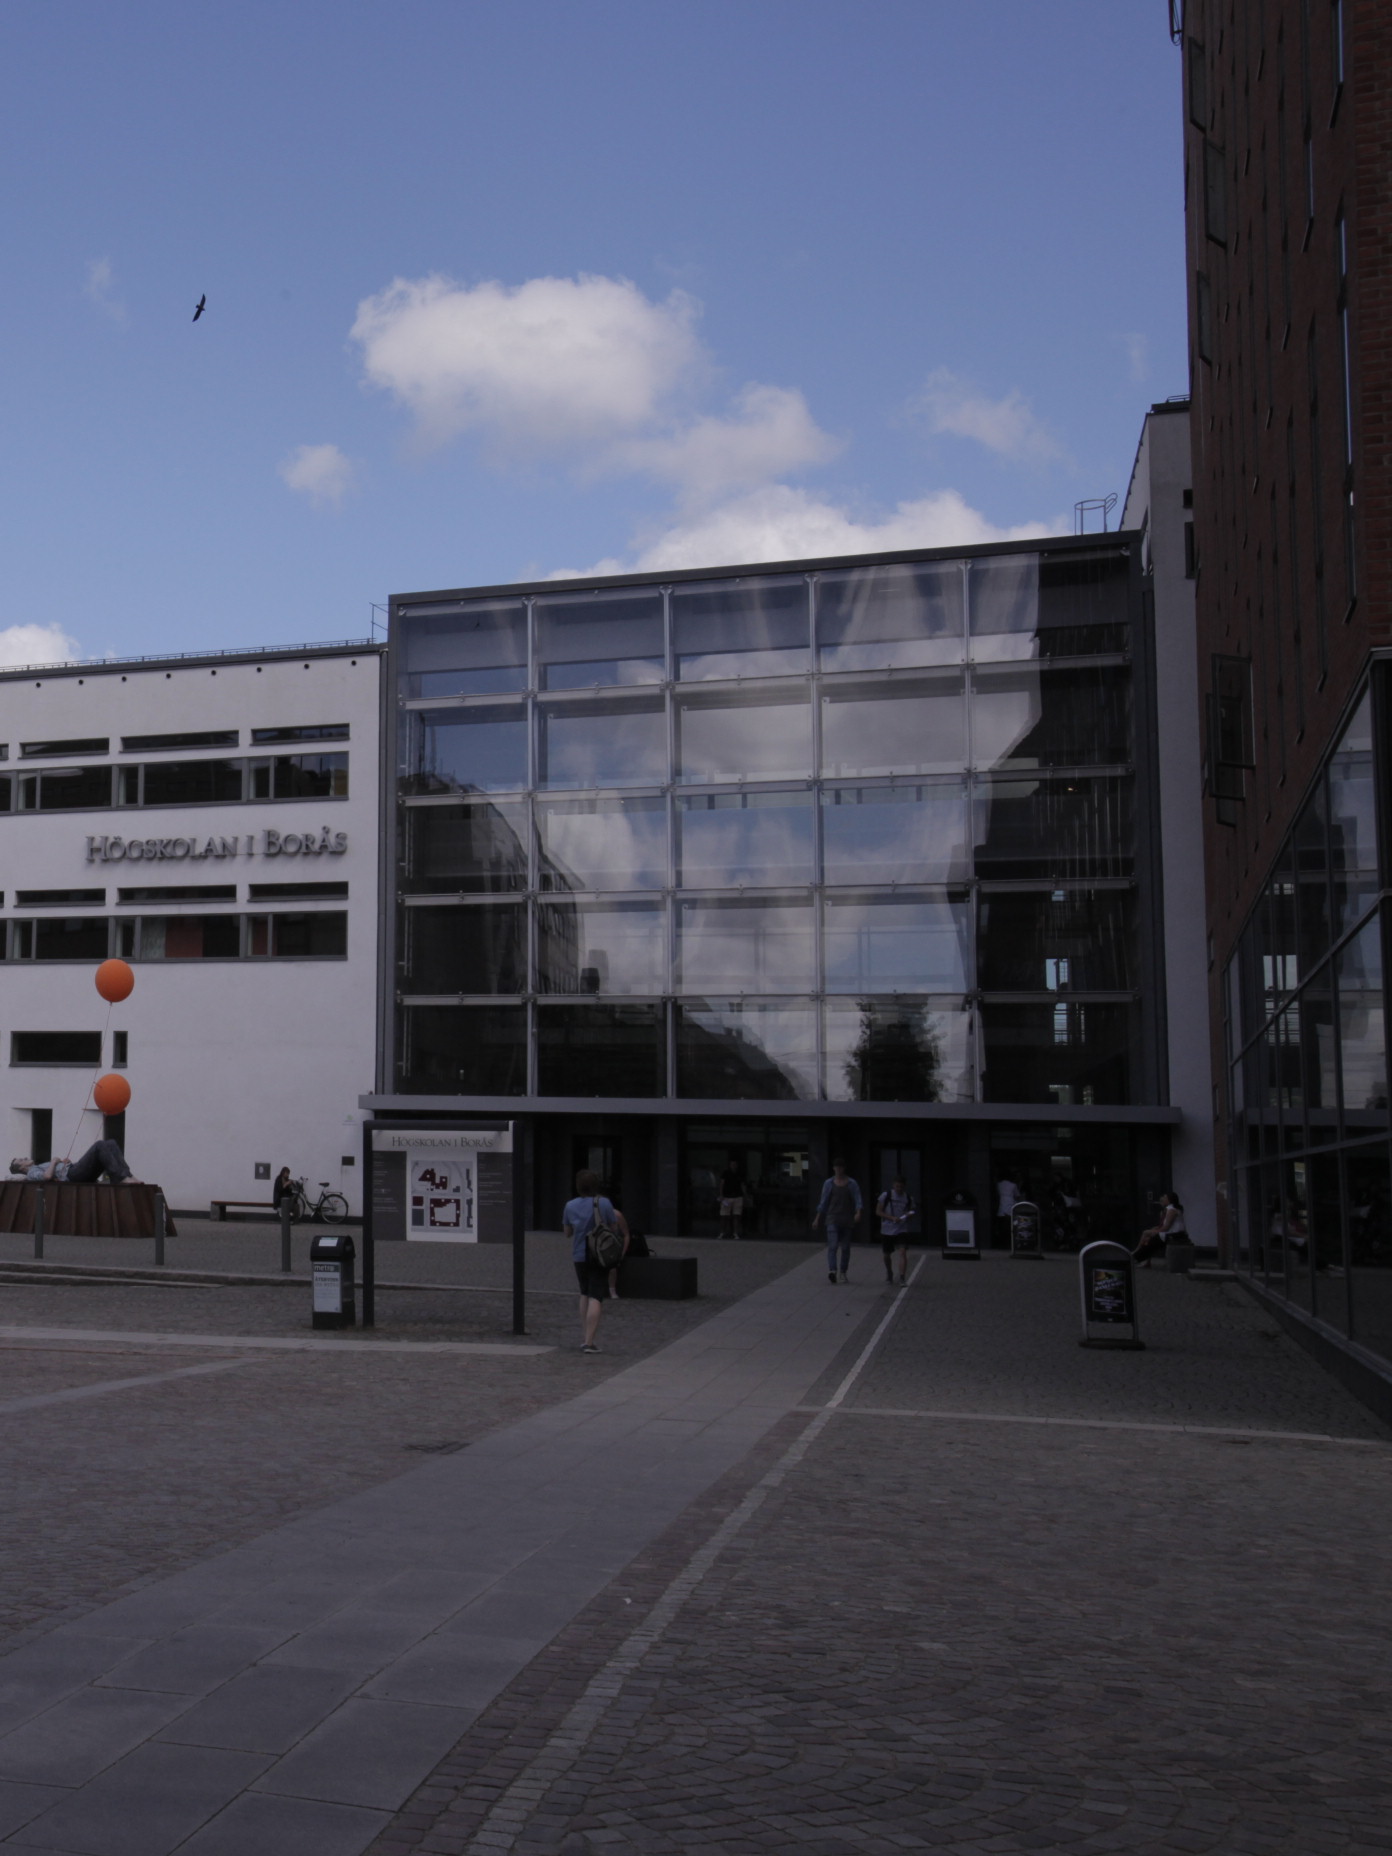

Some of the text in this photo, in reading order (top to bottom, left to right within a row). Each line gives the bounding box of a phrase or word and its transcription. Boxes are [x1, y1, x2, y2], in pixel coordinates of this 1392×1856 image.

[85, 825, 348, 863] HÖGSKOLAN I BORÅS
